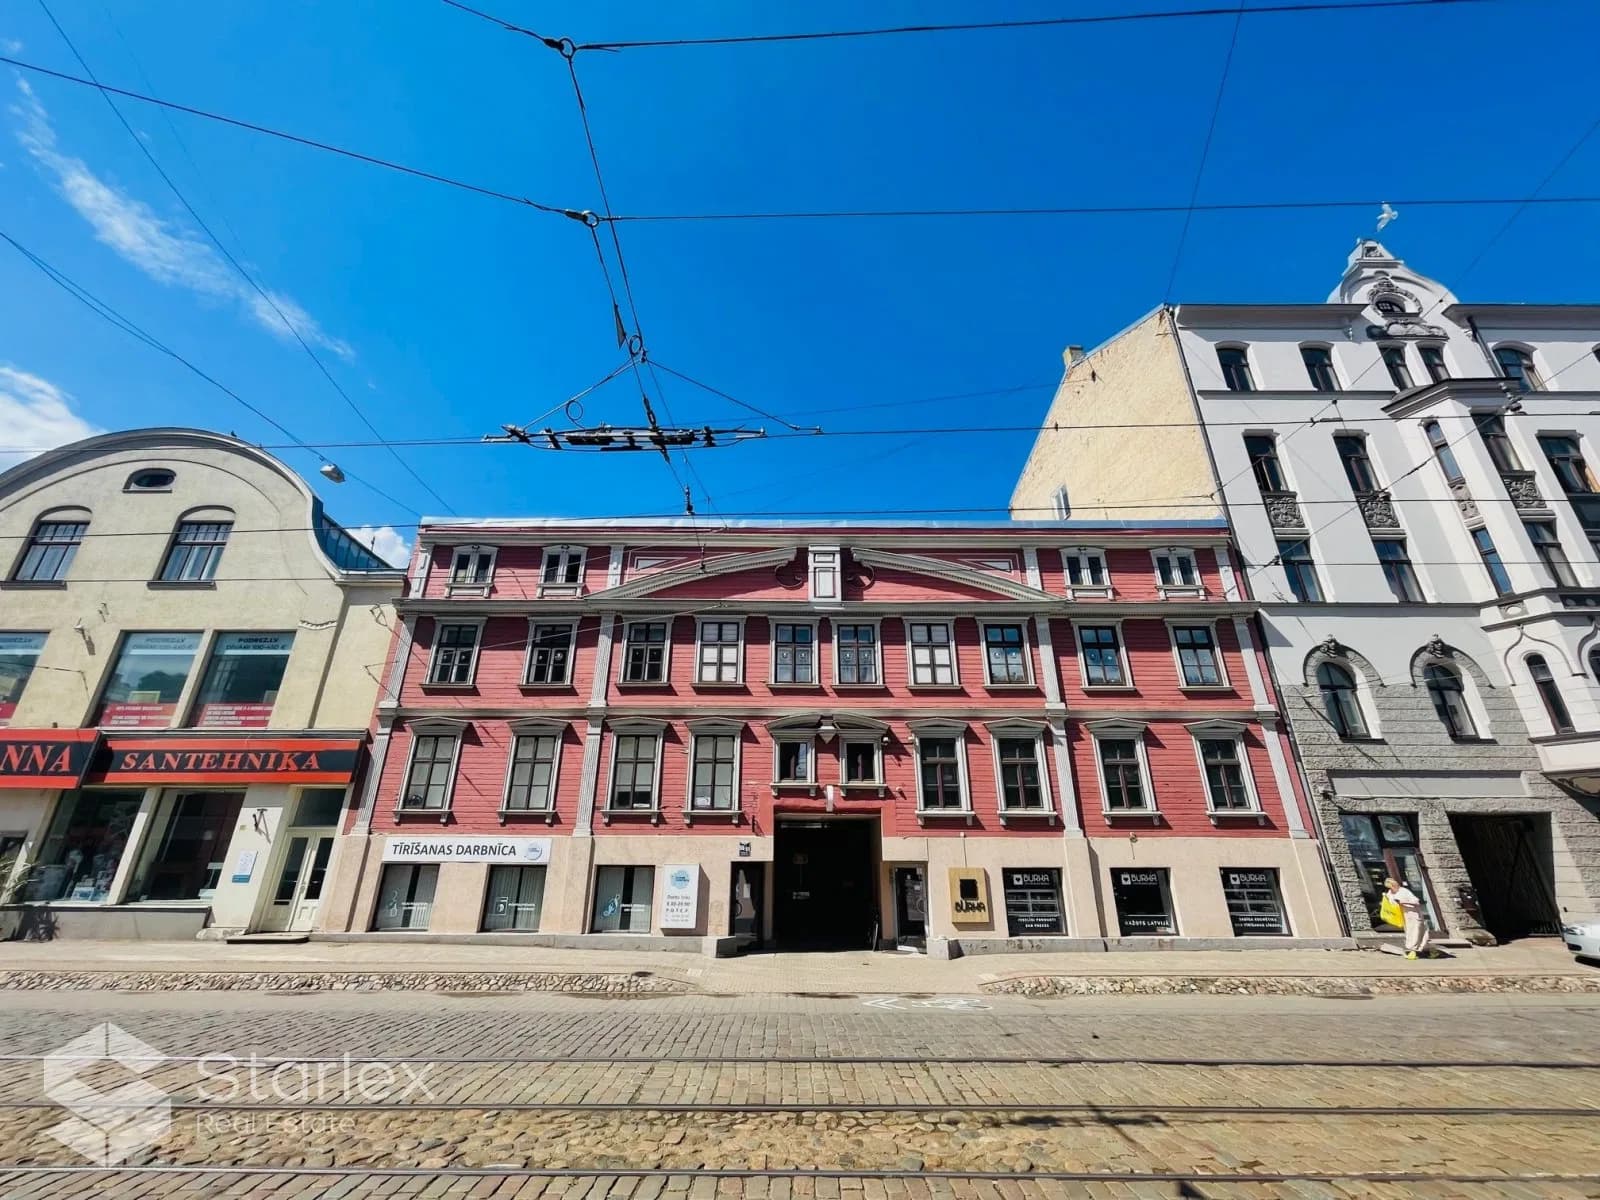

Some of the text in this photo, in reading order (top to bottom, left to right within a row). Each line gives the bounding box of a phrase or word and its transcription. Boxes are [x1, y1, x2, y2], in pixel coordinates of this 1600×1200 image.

[120, 751, 320, 771] SANTEHNIKA
[392, 842, 453, 855] TĪRĪŠANAS
[456, 843, 517, 856] DARBNĪCA
